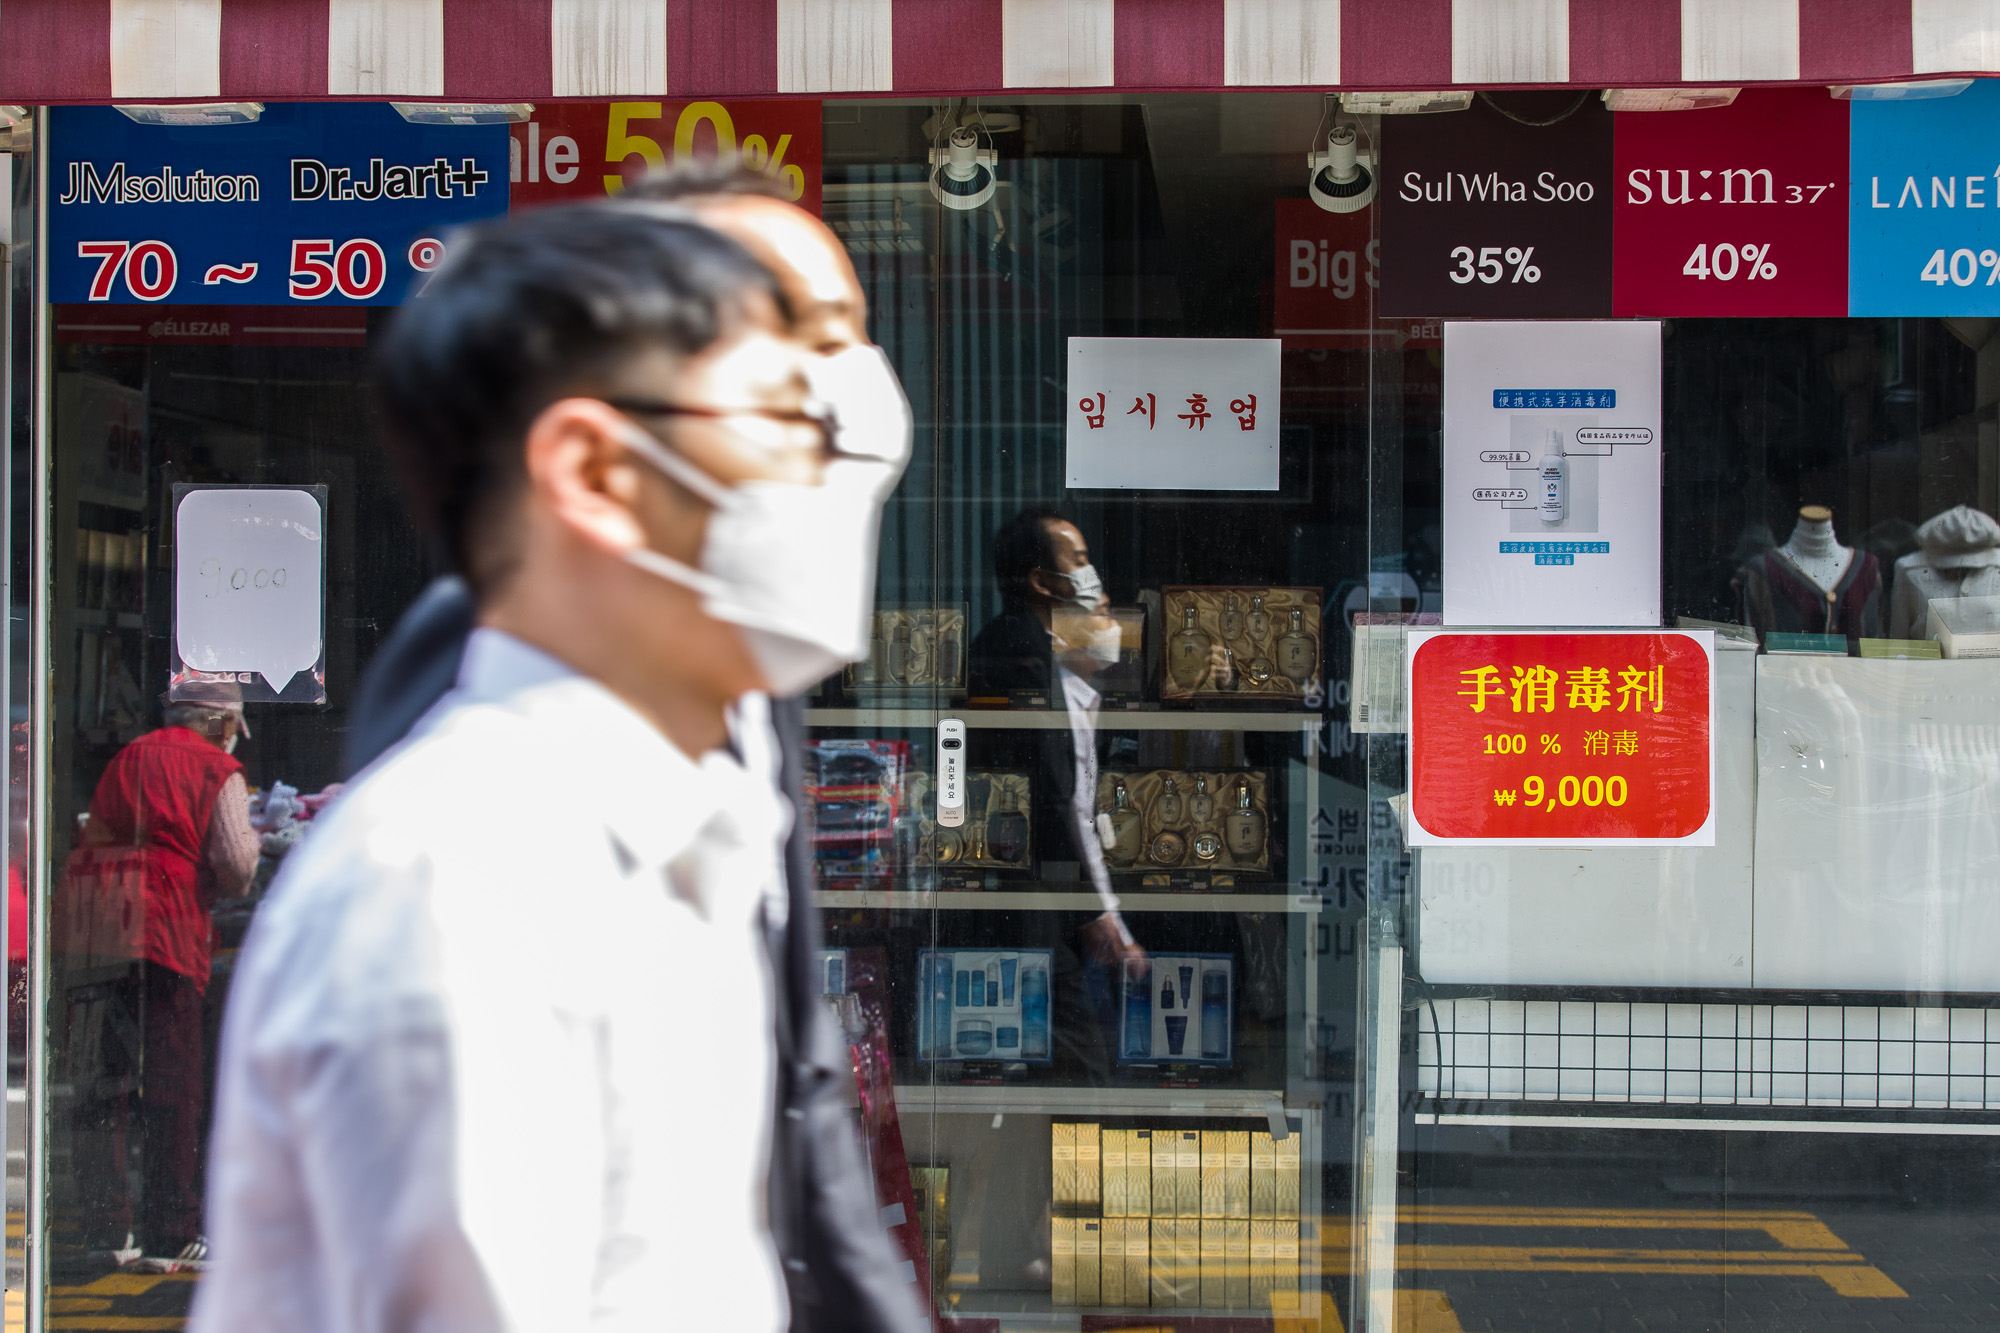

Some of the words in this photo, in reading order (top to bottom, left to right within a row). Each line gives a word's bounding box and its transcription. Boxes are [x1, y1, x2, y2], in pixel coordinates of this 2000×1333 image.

[60, 162, 260, 205] JMsolution
[290, 158, 488, 201] Dr.Jart+
[78, 240, 178, 302] 70
[288, 238, 386, 301] 50
[1289, 239, 1356, 300] Big
[1449, 246, 1541, 284] 35%
[1682, 242, 1778, 281] 40%
[1457, 664, 1665, 714] 手消毒剂
[1483, 733, 1527, 755] 100
[1582, 729, 1640, 757] 消毒
